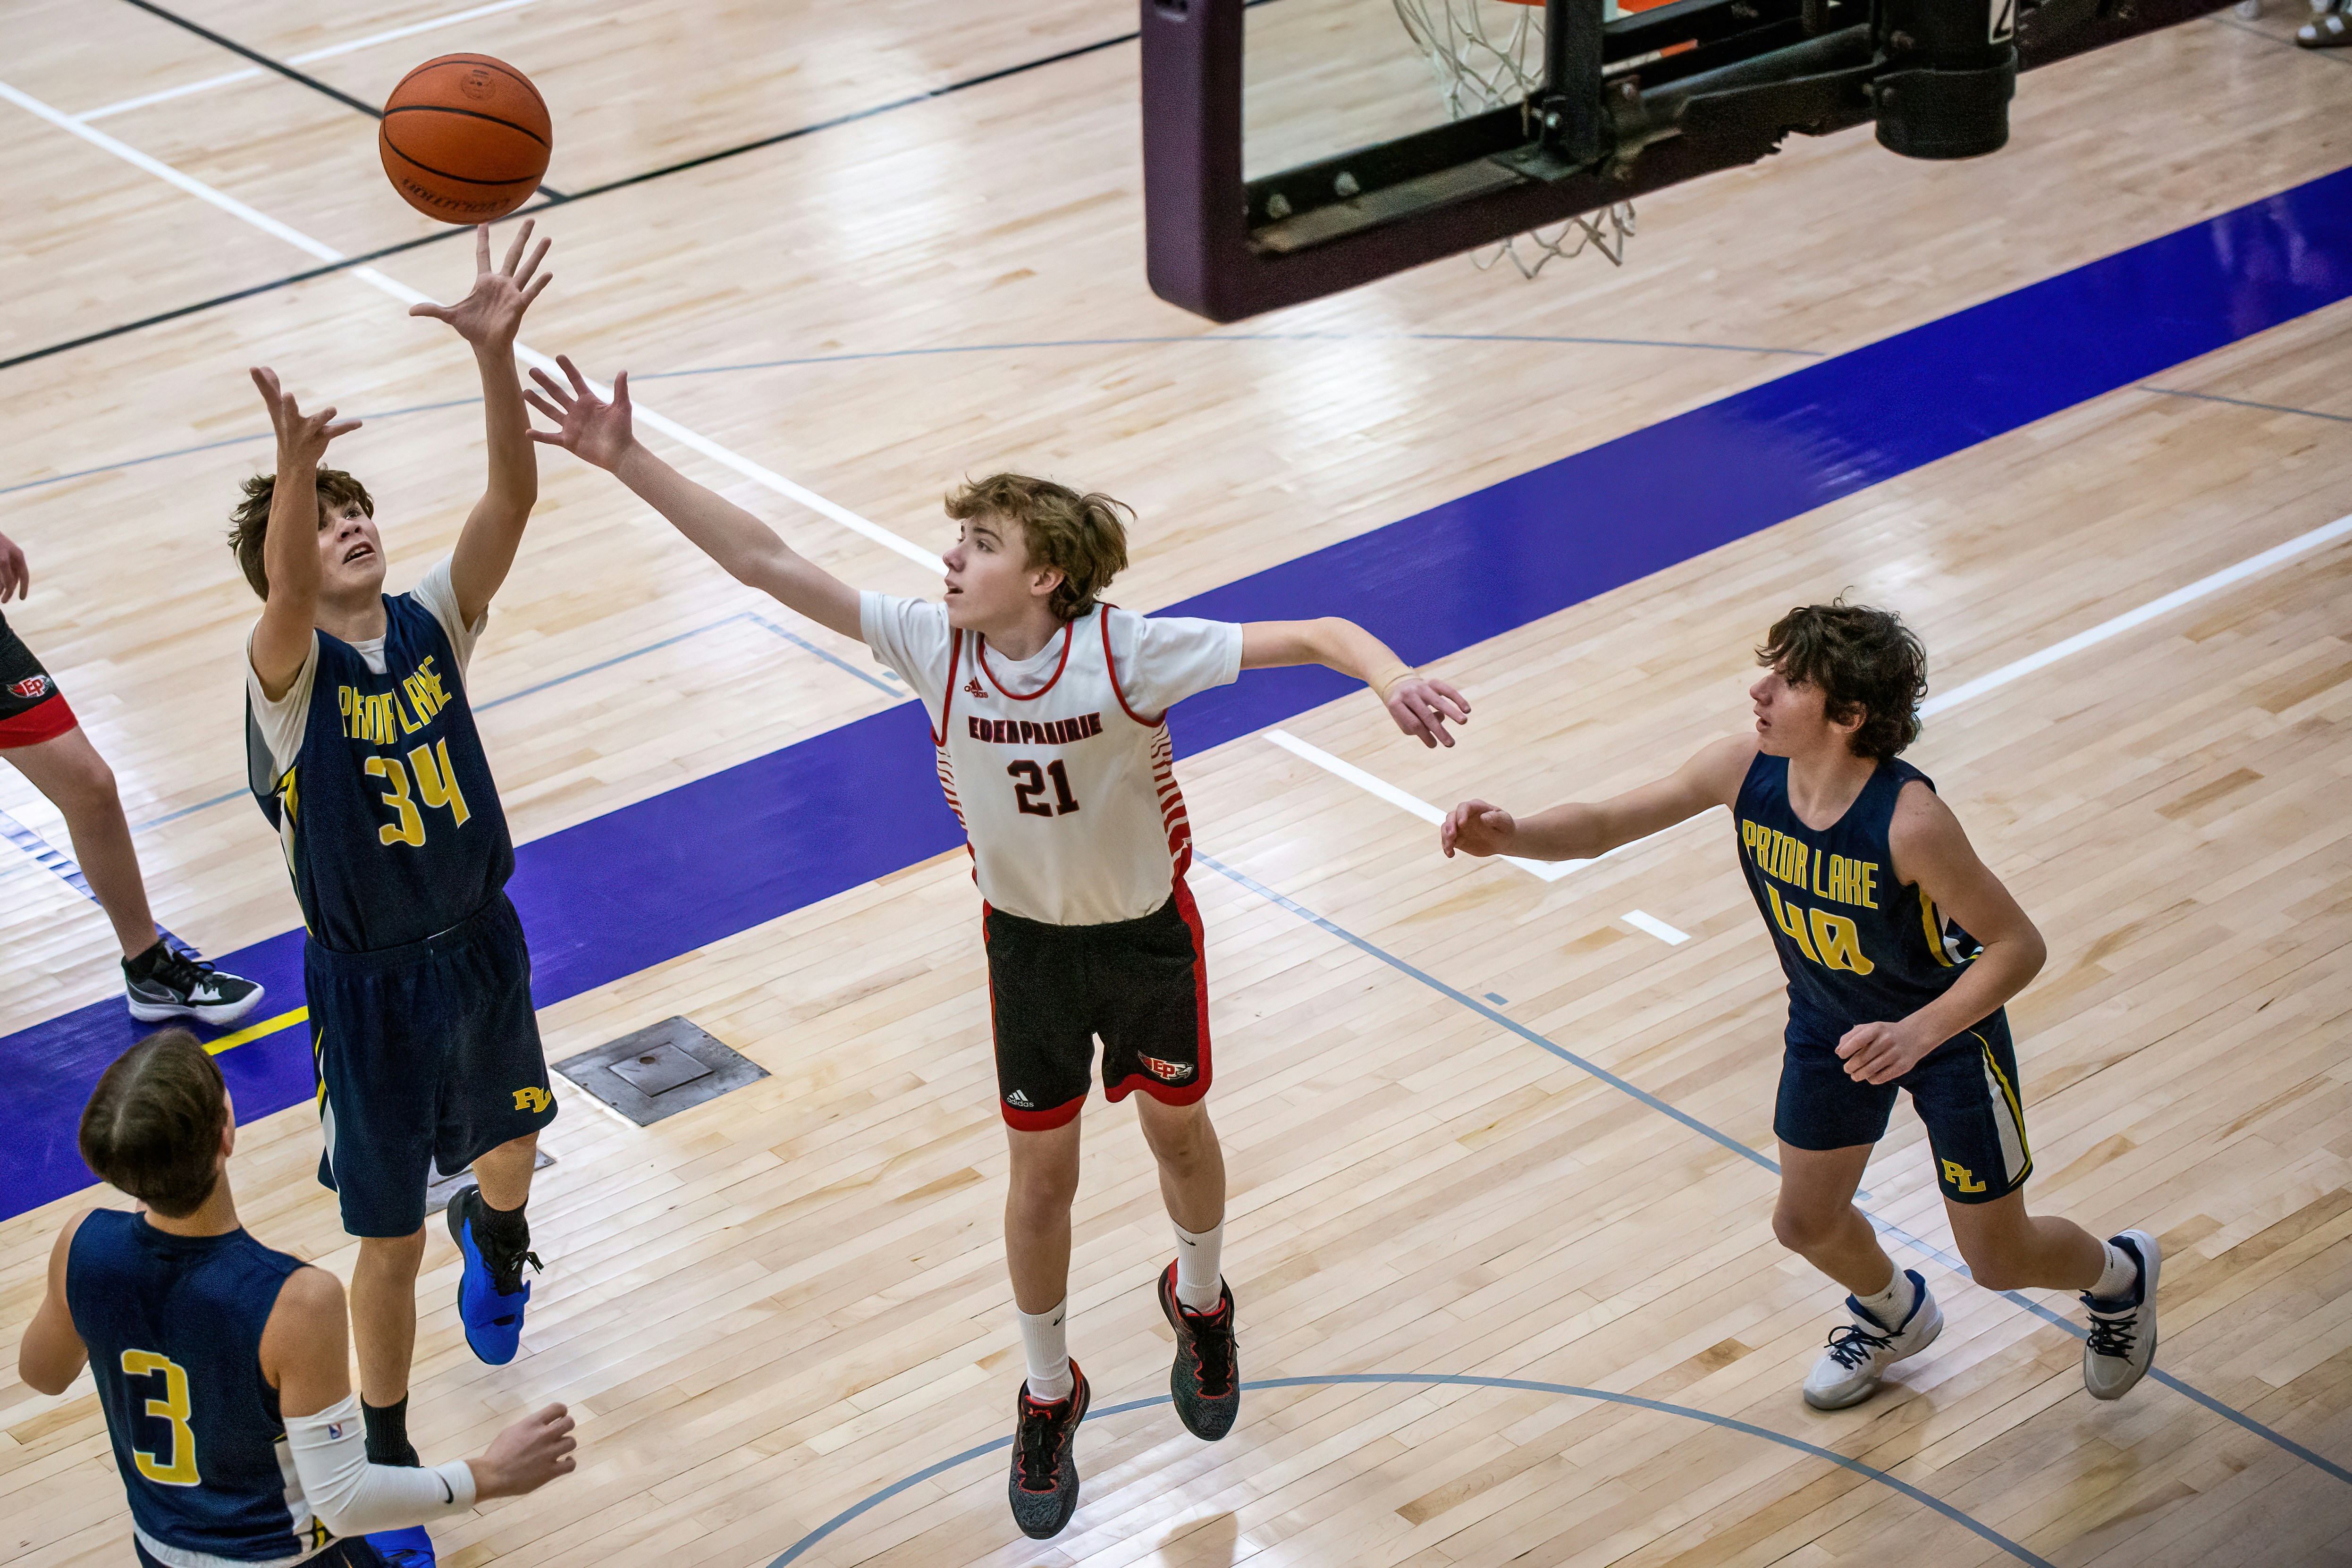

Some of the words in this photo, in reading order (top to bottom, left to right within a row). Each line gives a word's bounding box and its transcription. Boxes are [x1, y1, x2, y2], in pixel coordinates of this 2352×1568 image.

[338, 685, 398, 745] PROR
[364, 736, 471, 847] 34
[1007, 759, 1080, 817] 21
[1743, 819, 1809, 890] PRIOR
[1813, 849, 1879, 910] LAKE
[1764, 880, 1875, 976] 40
[1152, 1059, 1176, 1079] EP
[1006, 1096, 1034, 1107] adidas
[1941, 1157, 1987, 1192] PL
[120, 1348, 202, 1486] 3
